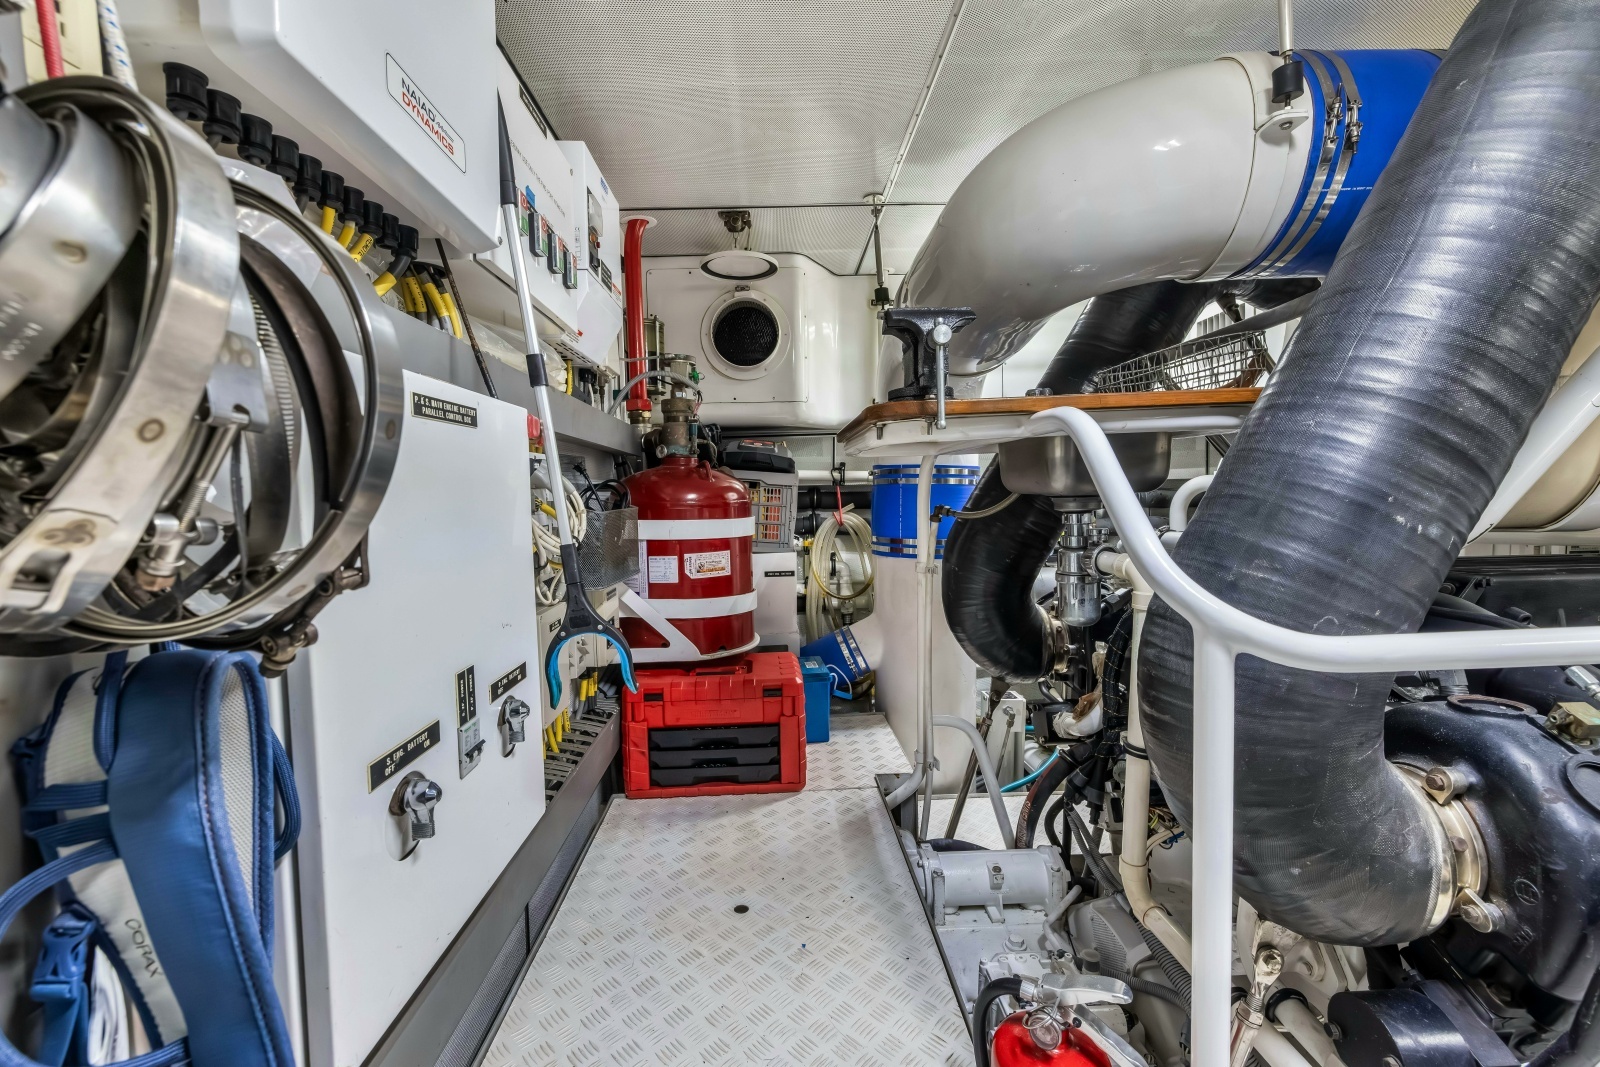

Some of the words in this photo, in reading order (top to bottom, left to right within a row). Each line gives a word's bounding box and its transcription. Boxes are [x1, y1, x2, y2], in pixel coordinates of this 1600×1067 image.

[402, 78, 436, 122] NAIAD
[402, 92, 454, 155] DYNAMICS
[422, 406, 445, 418] PARALLEL
[445, 412, 464, 422] CONTROL
[431, 400, 443, 409] MAIN
[443, 402, 459, 413] ENGINE
[459, 406, 476, 417] BATTERY
[384, 762, 396, 776] OFF
[423, 739, 431, 748] ON
[386, 757, 393, 766] S.
[393, 748, 405, 760] ENG.
[407, 731, 428, 751] BATTERY
